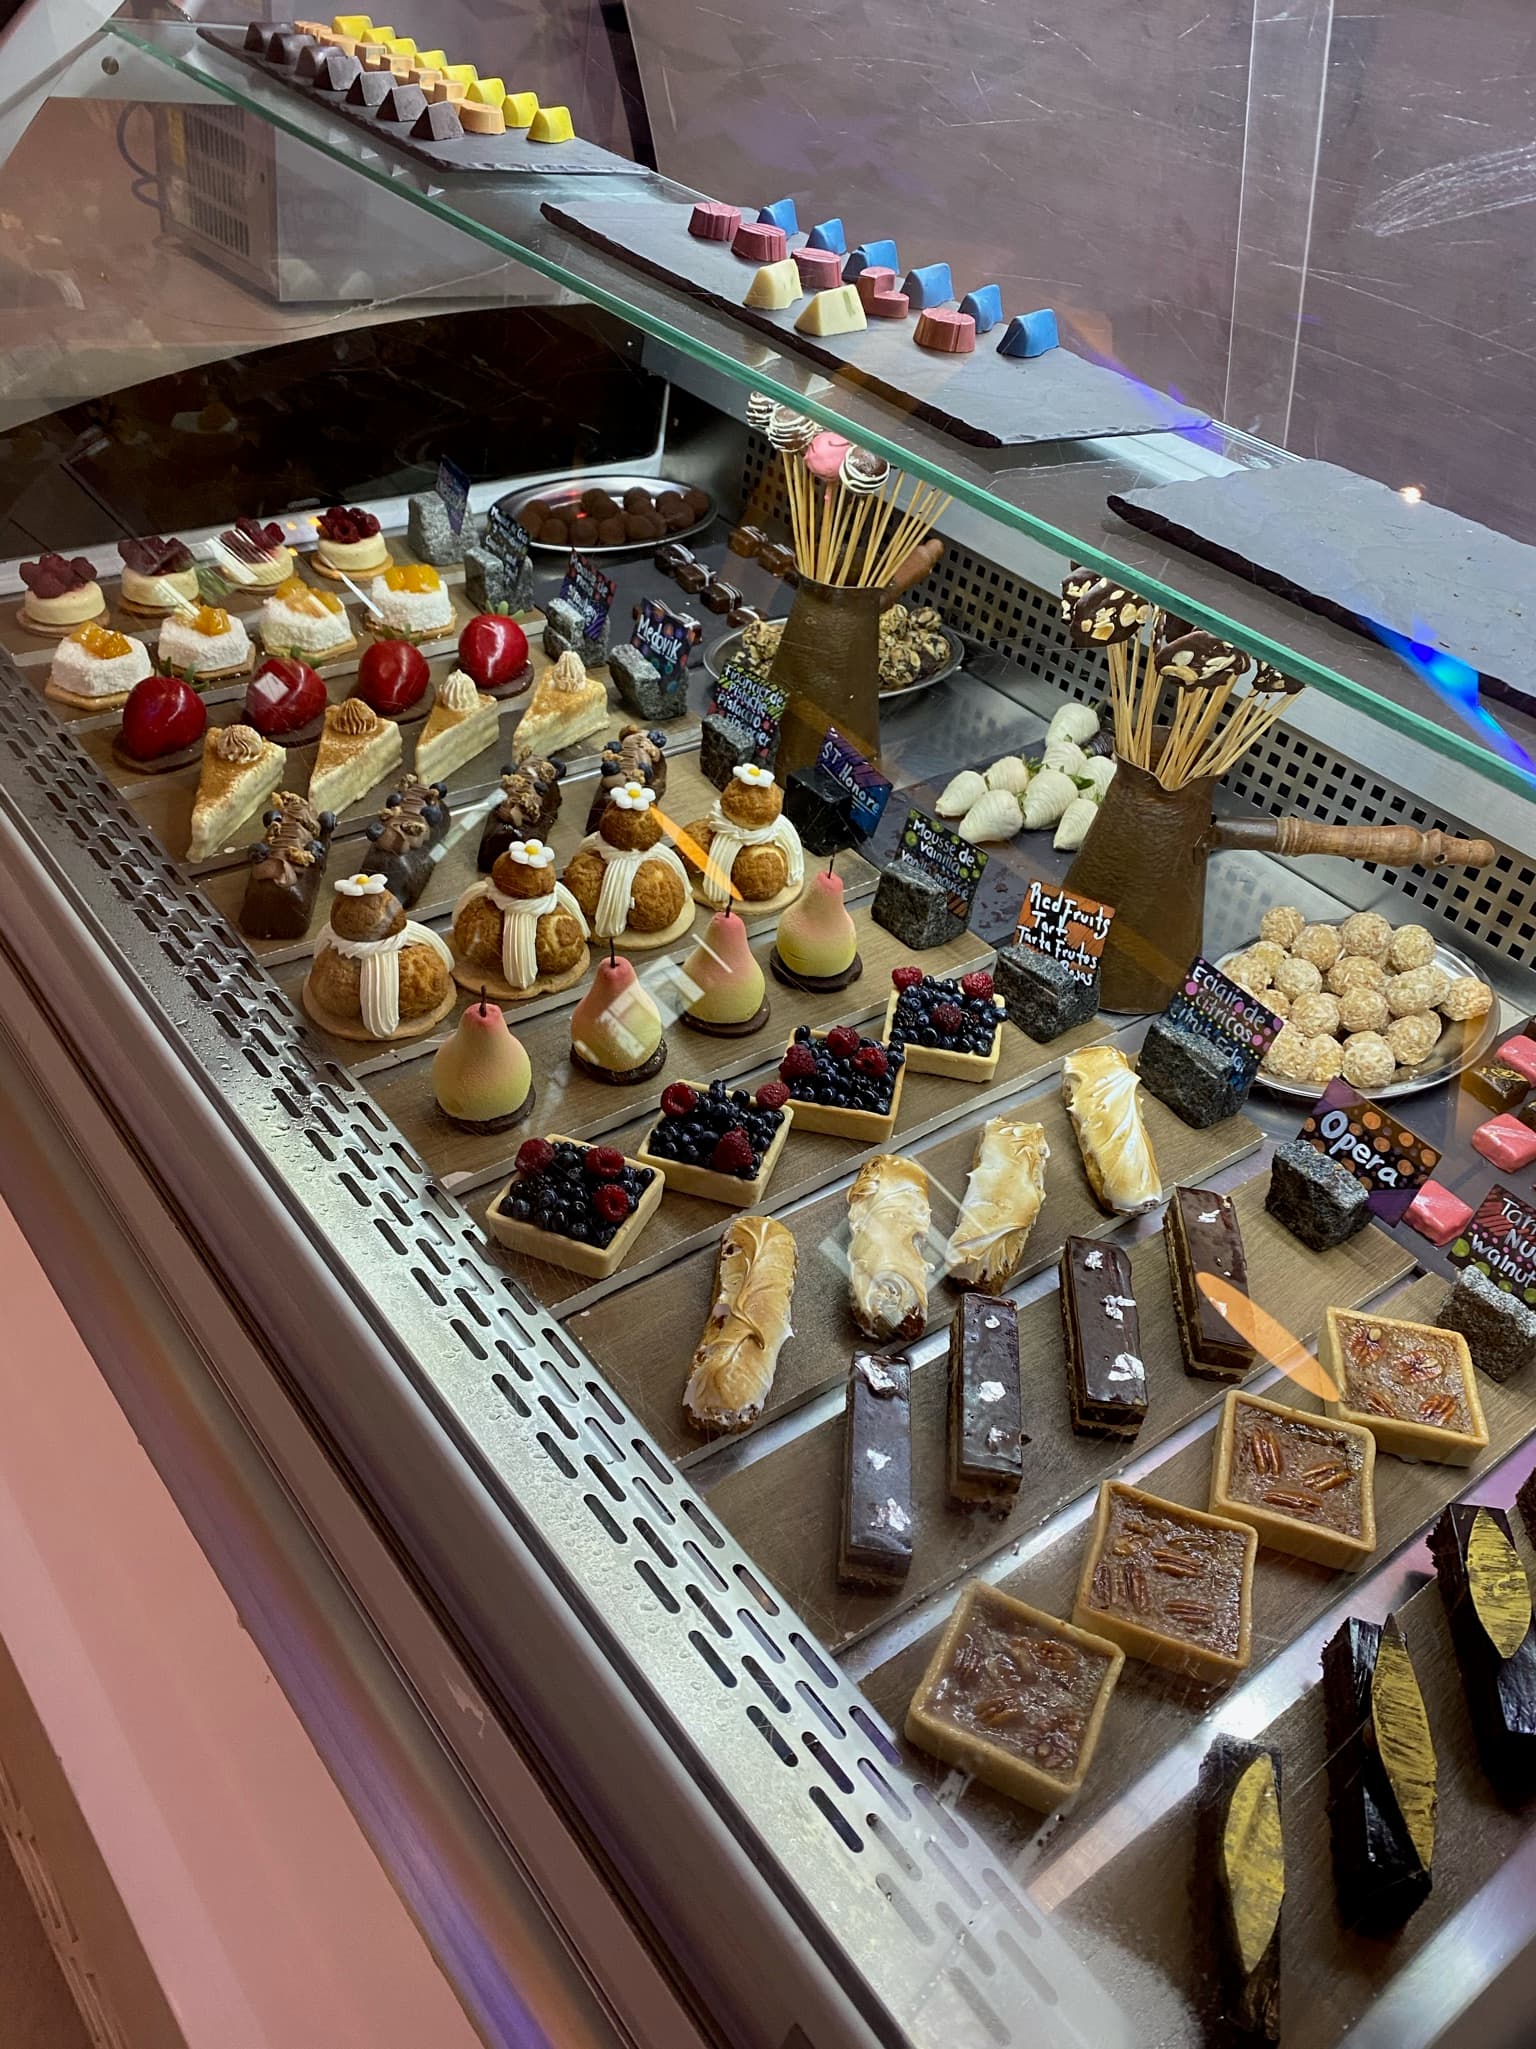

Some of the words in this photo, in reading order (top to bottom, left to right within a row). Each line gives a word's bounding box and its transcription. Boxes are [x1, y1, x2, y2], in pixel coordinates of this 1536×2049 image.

[637, 613, 682, 660] Medovik
[770, 691, 784, 708] de
[913, 818, 957, 857] Mousse
[958, 847, 975, 867] de
[1030, 881, 1064, 913] Red
[1061, 898, 1111, 940] Fruits
[1017, 925, 1052, 952] Tarta
[1055, 938, 1098, 970] Frutos
[1242, 1005, 1266, 1031] de
[1320, 1110, 1399, 1188] Opera
